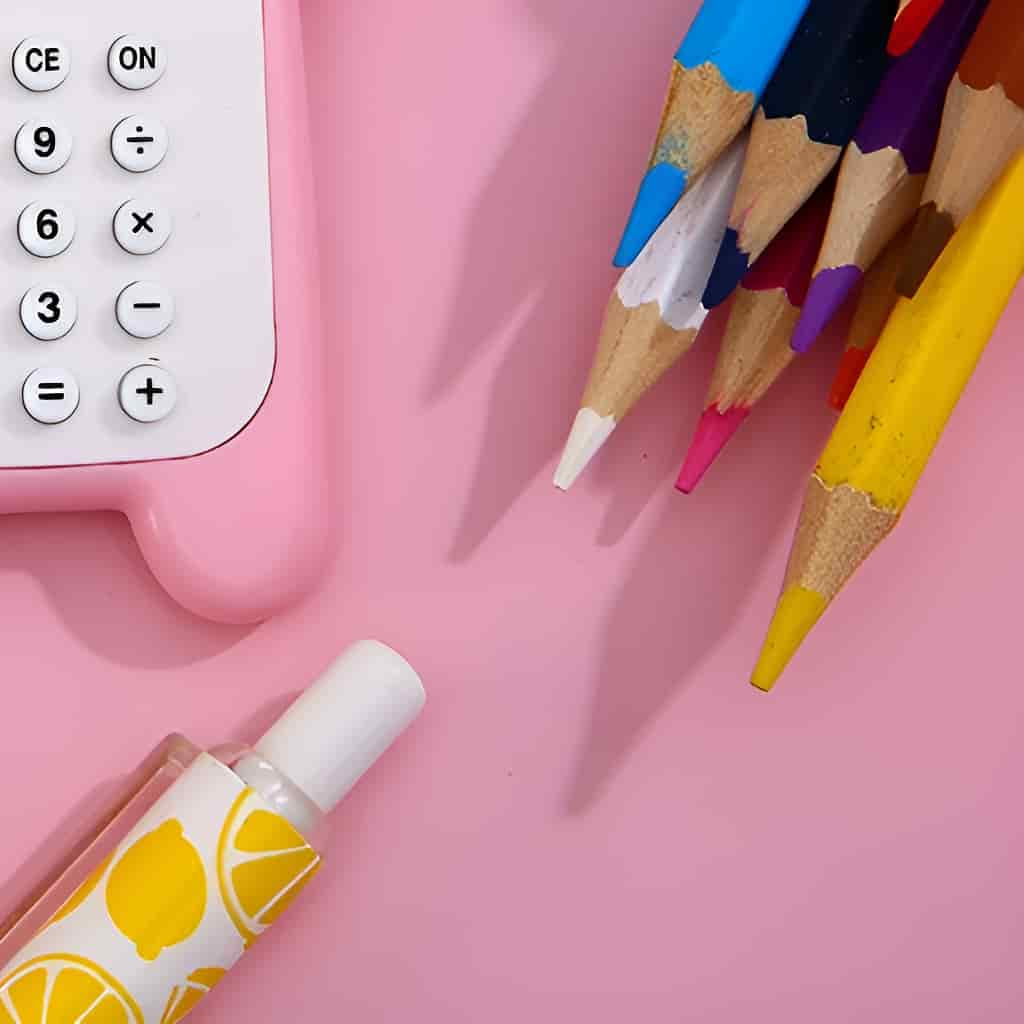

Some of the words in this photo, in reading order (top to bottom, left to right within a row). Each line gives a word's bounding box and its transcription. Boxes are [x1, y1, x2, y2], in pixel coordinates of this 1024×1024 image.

[24, 46, 61, 73] CE
[117, 45, 157, 72] ON
[32, 125, 57, 159] 9
[35, 207, 60, 241] 6
[36, 290, 62, 325] 3
